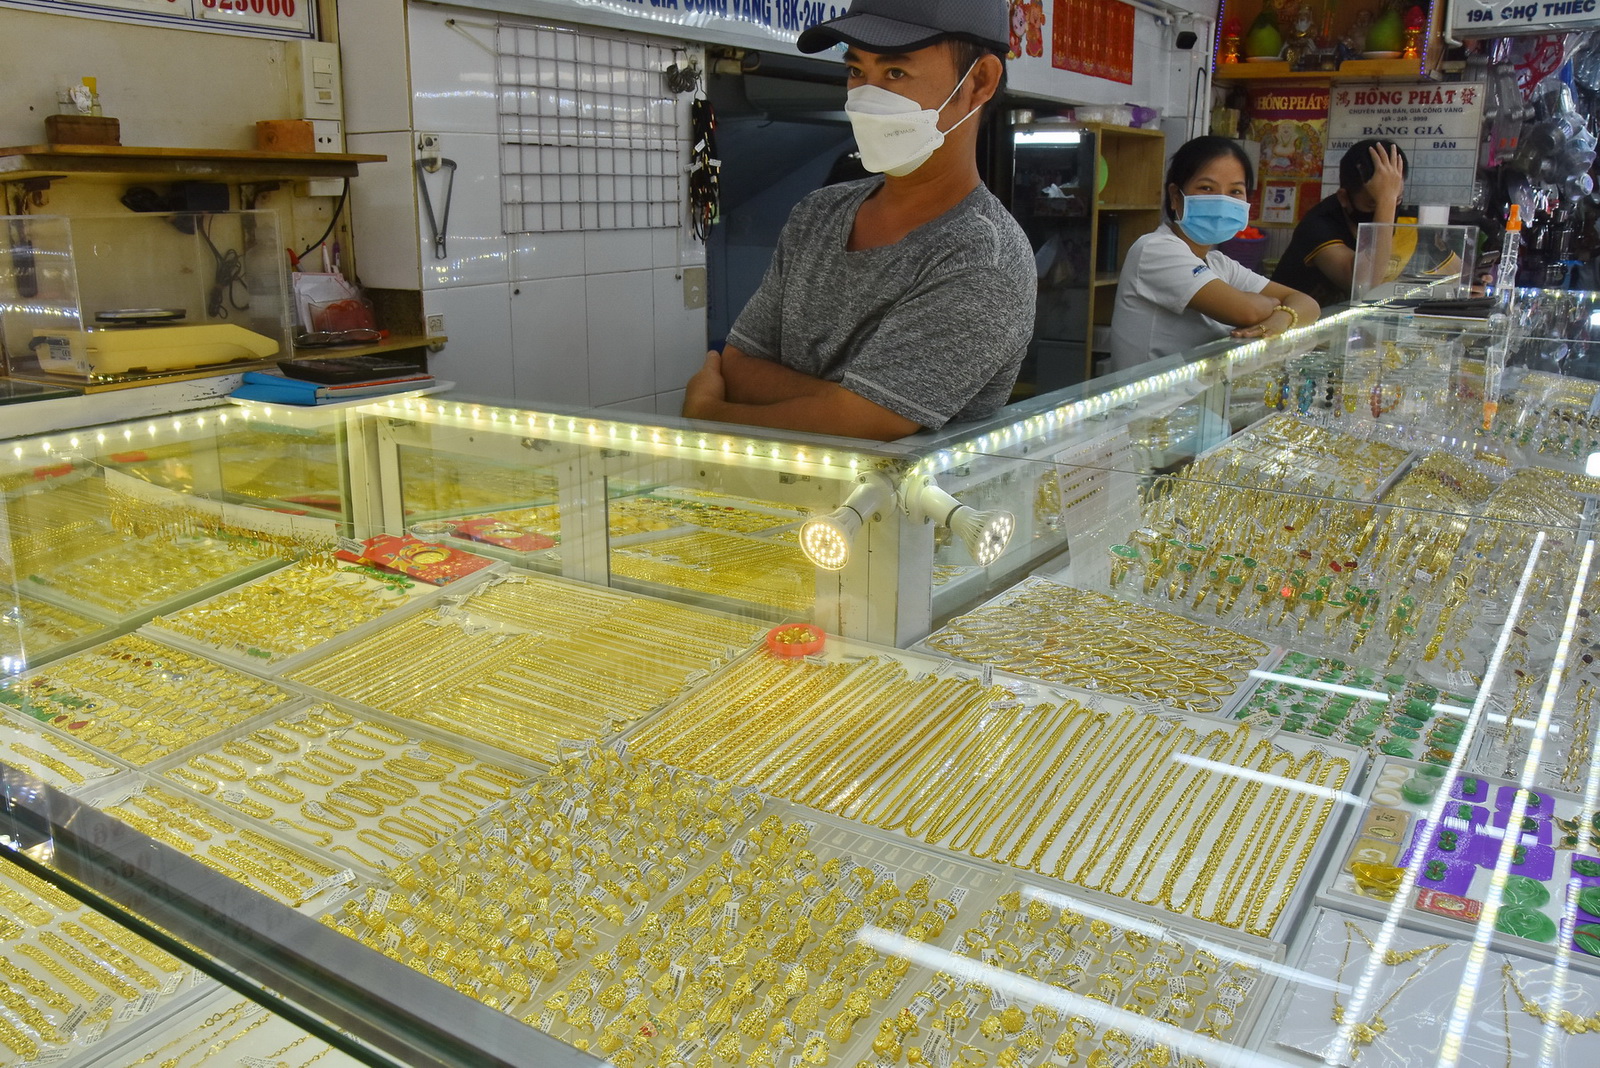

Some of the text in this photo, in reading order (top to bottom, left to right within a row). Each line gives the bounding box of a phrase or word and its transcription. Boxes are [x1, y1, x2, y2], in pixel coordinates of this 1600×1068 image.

[1466, 9, 1494, 22] 19A
[1500, 2, 1538, 21] CHỢ
[1288, 93, 1321, 110] PHÁT
[1354, 87, 1403, 105] HỒNG
[1408, 86, 1457, 105] PHÁT
[1423, 105, 1442, 113] CÔNG
[1414, 124, 1444, 135] GIÁ
[1433, 140, 1457, 149] BÁN
[1274, 188, 1286, 204] 5
